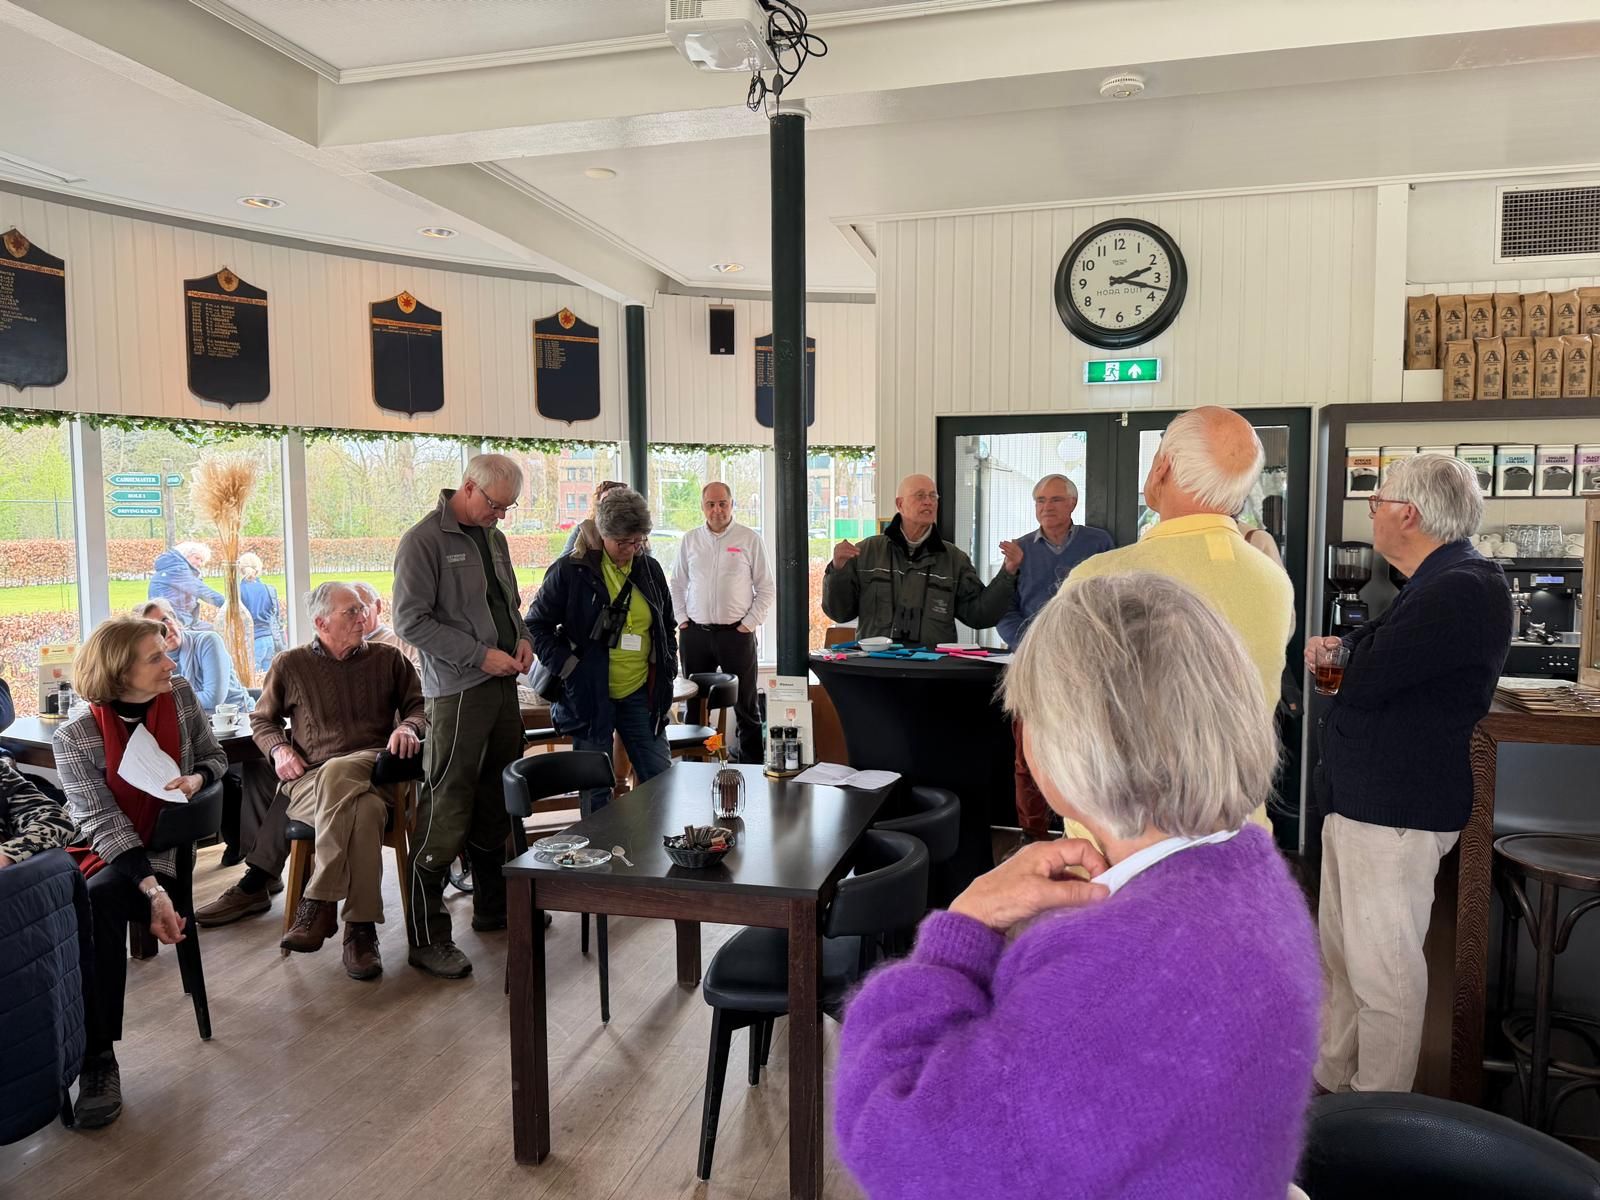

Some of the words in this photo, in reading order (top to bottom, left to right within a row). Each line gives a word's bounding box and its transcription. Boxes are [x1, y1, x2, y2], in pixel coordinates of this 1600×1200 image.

[1114, 238, 1126, 250] 12
[1137, 242, 1141, 253] 1
[1097, 245, 1107, 257] 11
[1082, 259, 1095, 271] 10
[1149, 254, 1157, 265] 2
[1154, 272, 1161, 283] 3
[1079, 278, 1087, 289] 9
[1084, 296, 1092, 307] 8
[1146, 291, 1156, 301] 4
[1098, 307, 1106, 319] 7
[1134, 305, 1142, 316] 5
[1115, 311, 1124, 322] 6
